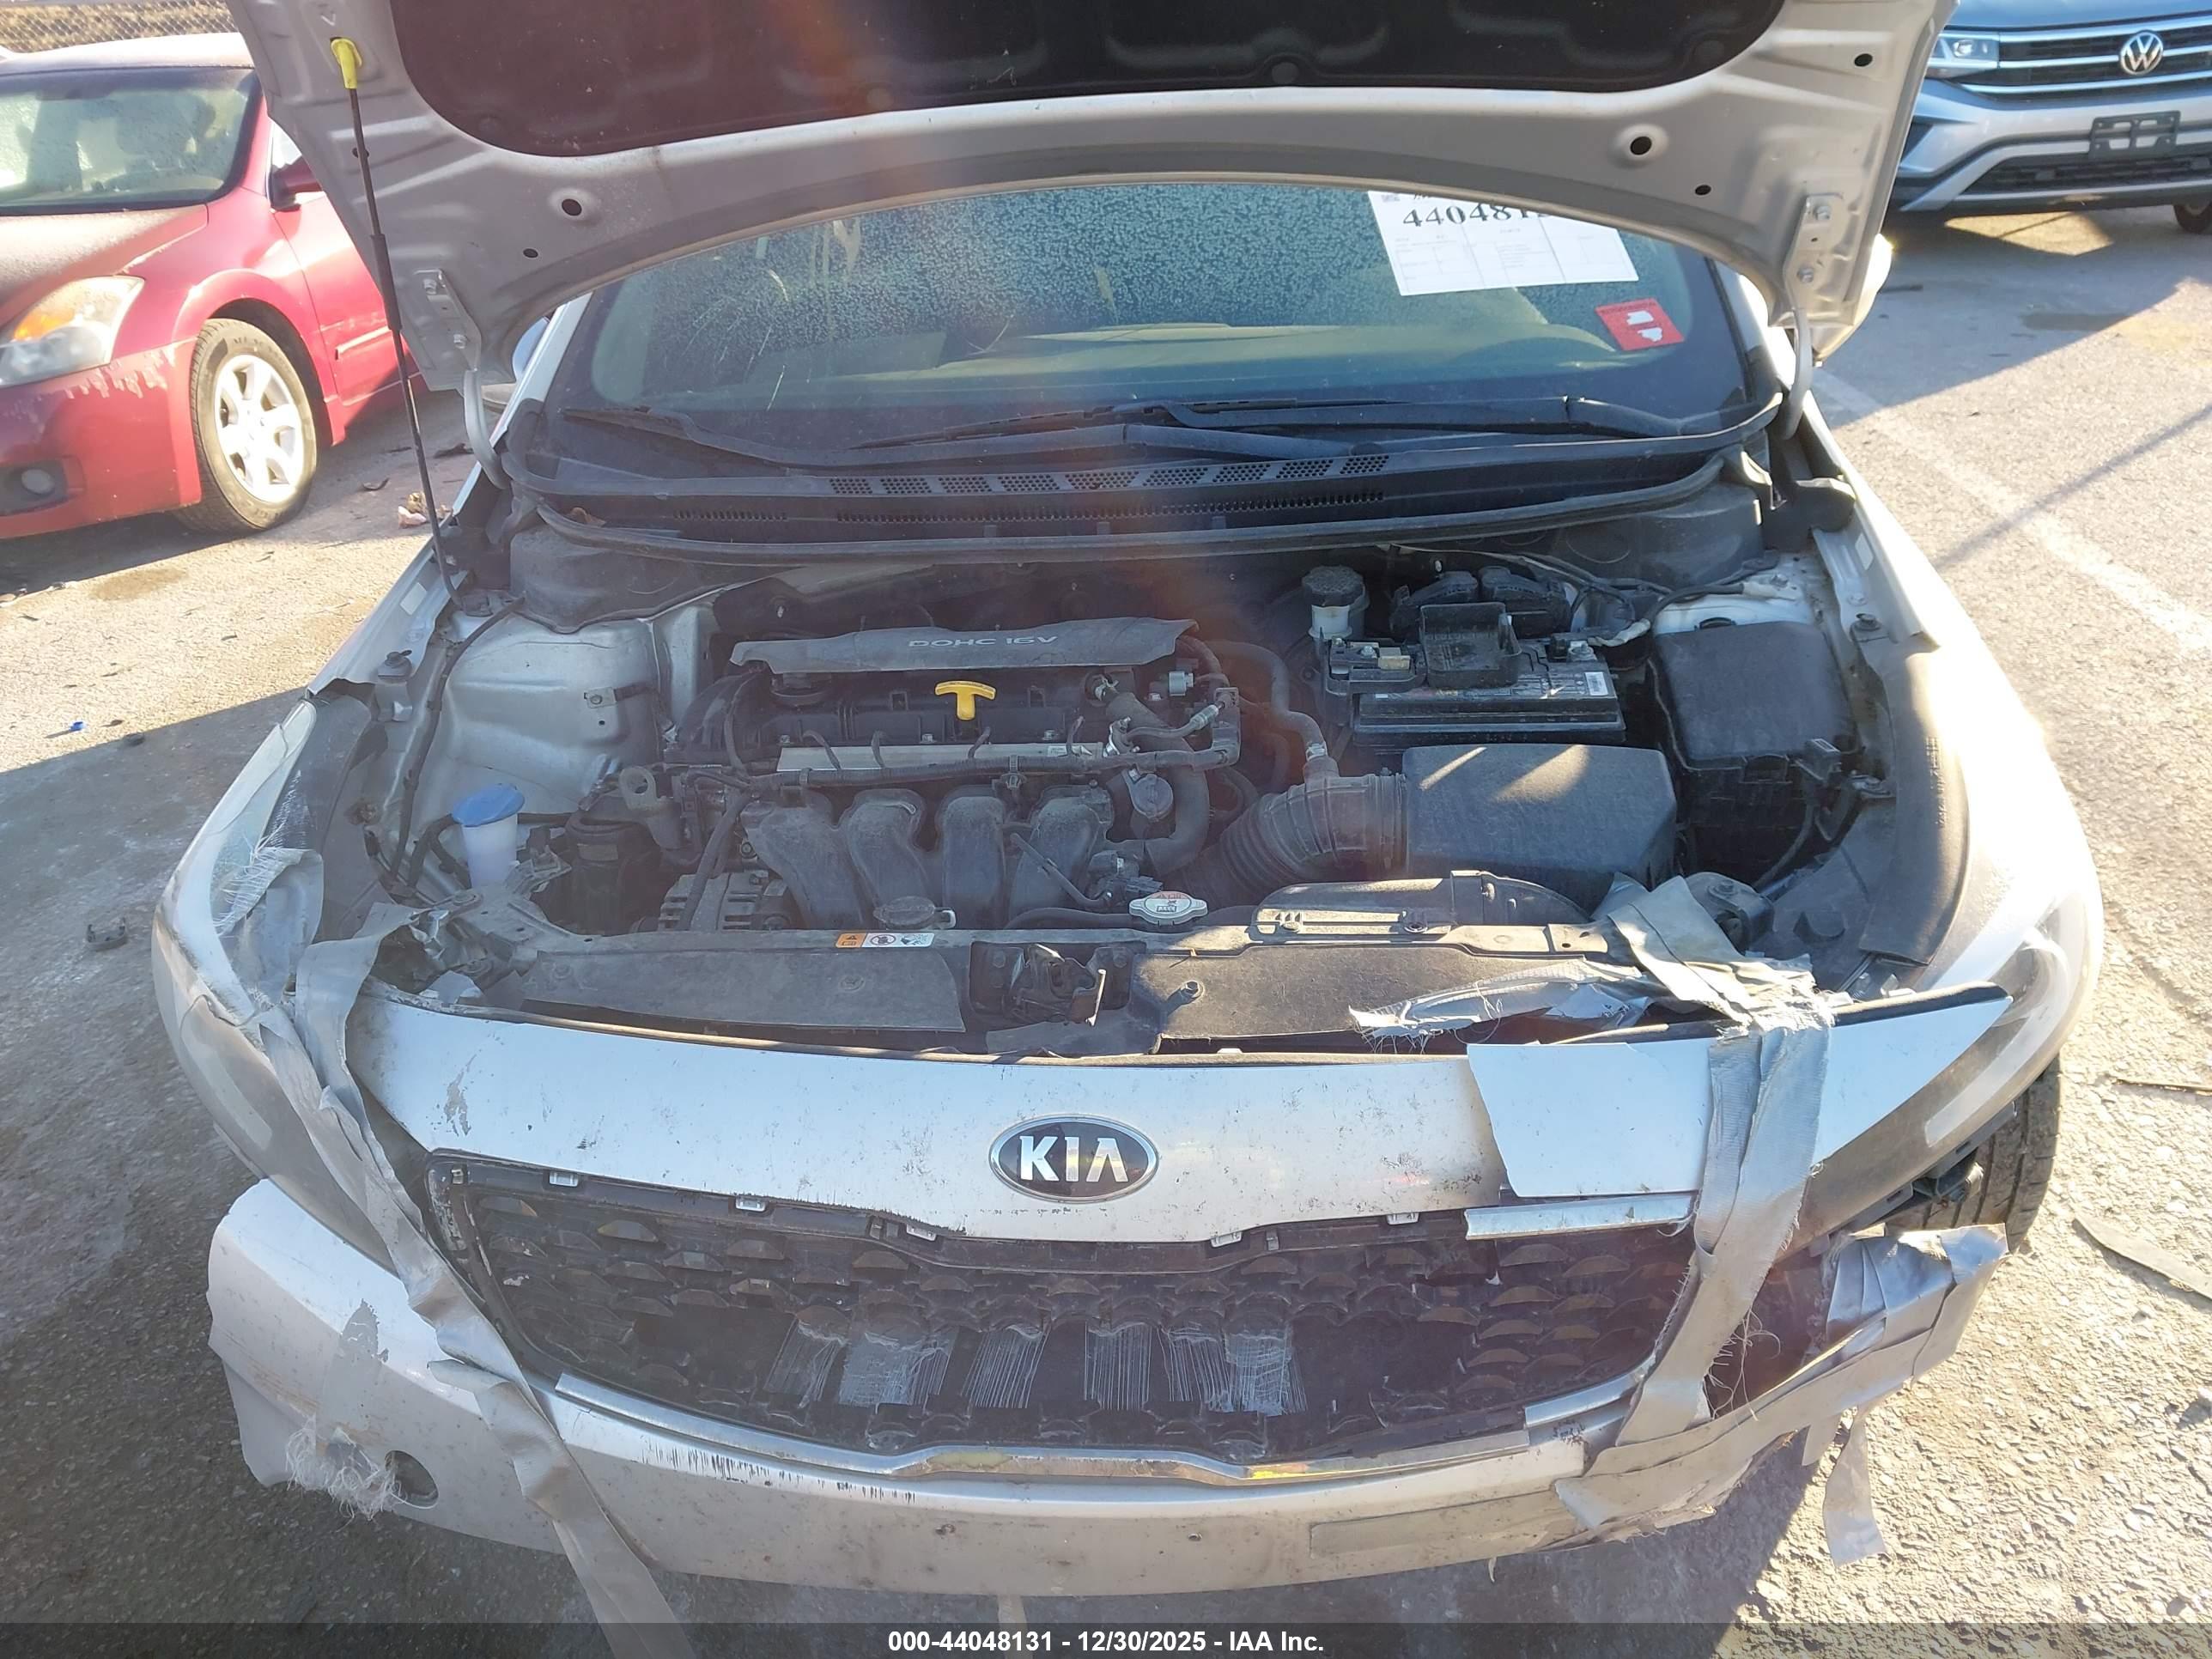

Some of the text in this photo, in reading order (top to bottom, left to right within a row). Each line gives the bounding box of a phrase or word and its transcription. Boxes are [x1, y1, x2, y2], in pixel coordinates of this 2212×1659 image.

[2121, 33, 2163, 75] VW
[908, 635, 1058, 647] DOHC 16V
[1019, 1135, 1129, 1182] KIA
